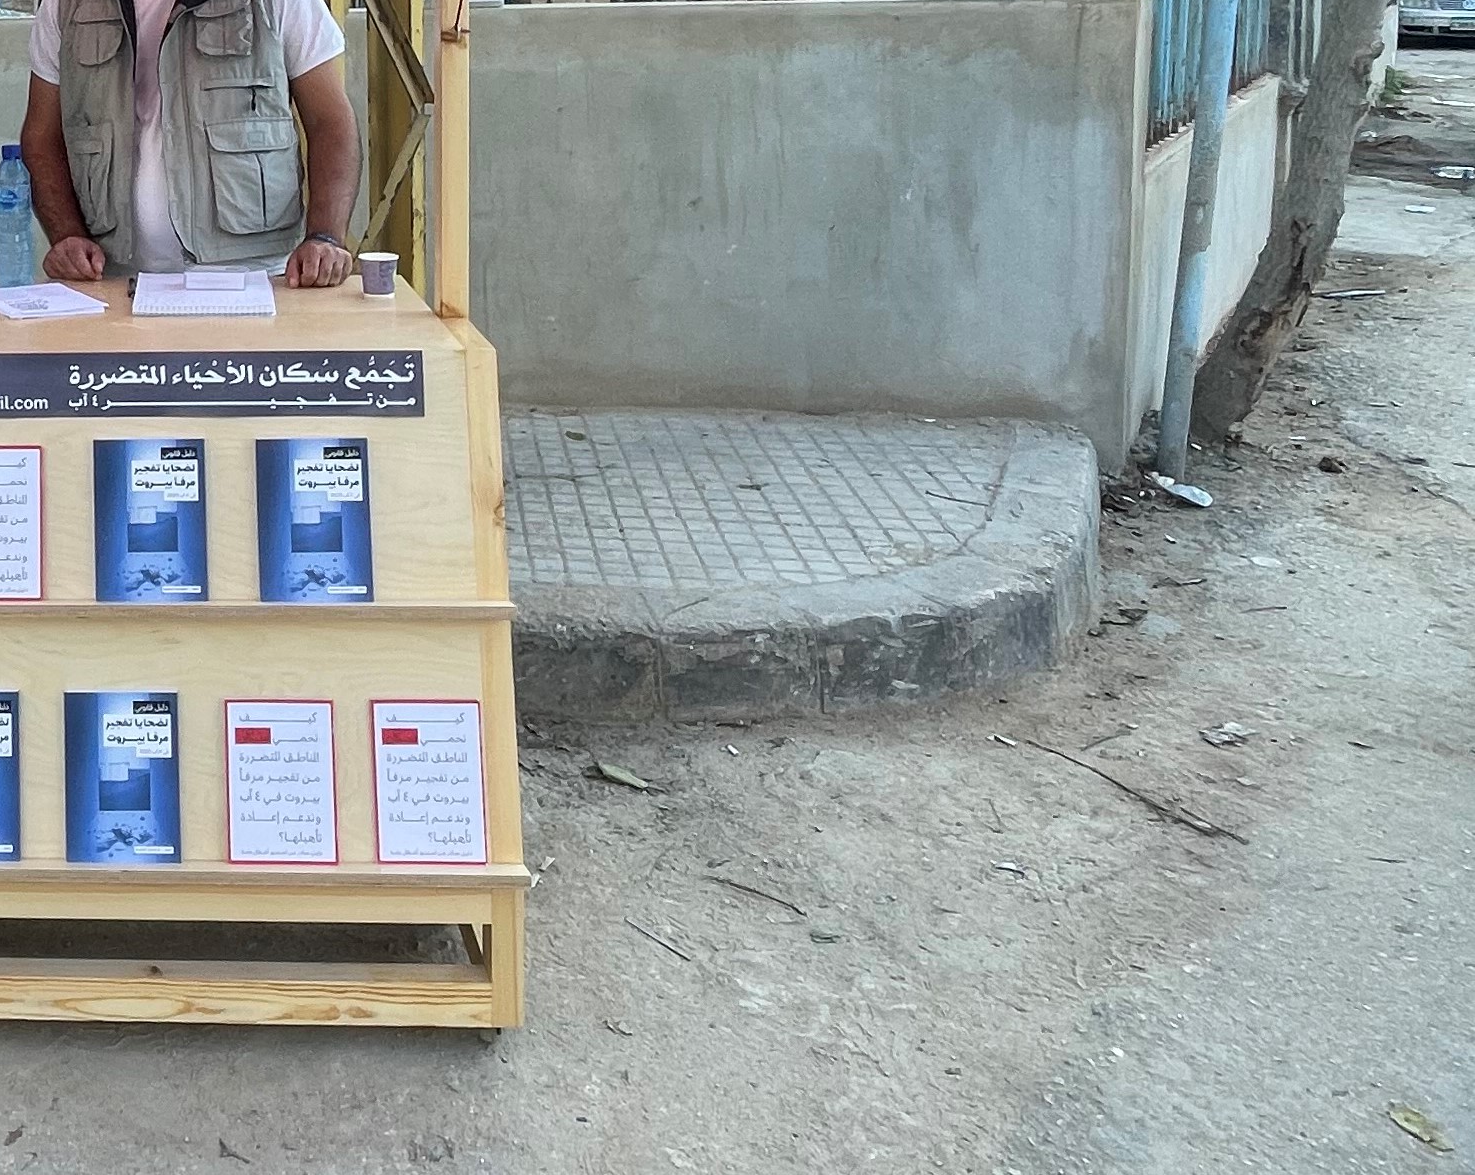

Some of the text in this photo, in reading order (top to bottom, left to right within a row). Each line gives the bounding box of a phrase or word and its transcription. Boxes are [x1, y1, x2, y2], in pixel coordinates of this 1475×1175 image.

[69, 364, 167, 391] المتضررة
[100, 392, 375, 411] تفجير
[376, 394, 417, 410] من
[134, 463, 195, 475] لضحايا تفجير
[297, 463, 359, 475] لضحايا تفجير
[135, 479, 173, 489] بيروت
[298, 479, 337, 489] بيروت
[11, 517, 28, 526] من
[106, 718, 168, 730] لضحايا تفجير
[239, 712, 318, 724] كيف
[386, 712, 465, 725] كيف
[107, 734, 146, 745] بيروت
[302, 775, 320, 785] من
[451, 776, 469, 785] من
[264, 793, 281, 806] في
[285, 794, 320, 804] بيروت
[412, 793, 430, 806] في
[434, 794, 469, 804] بيروت
